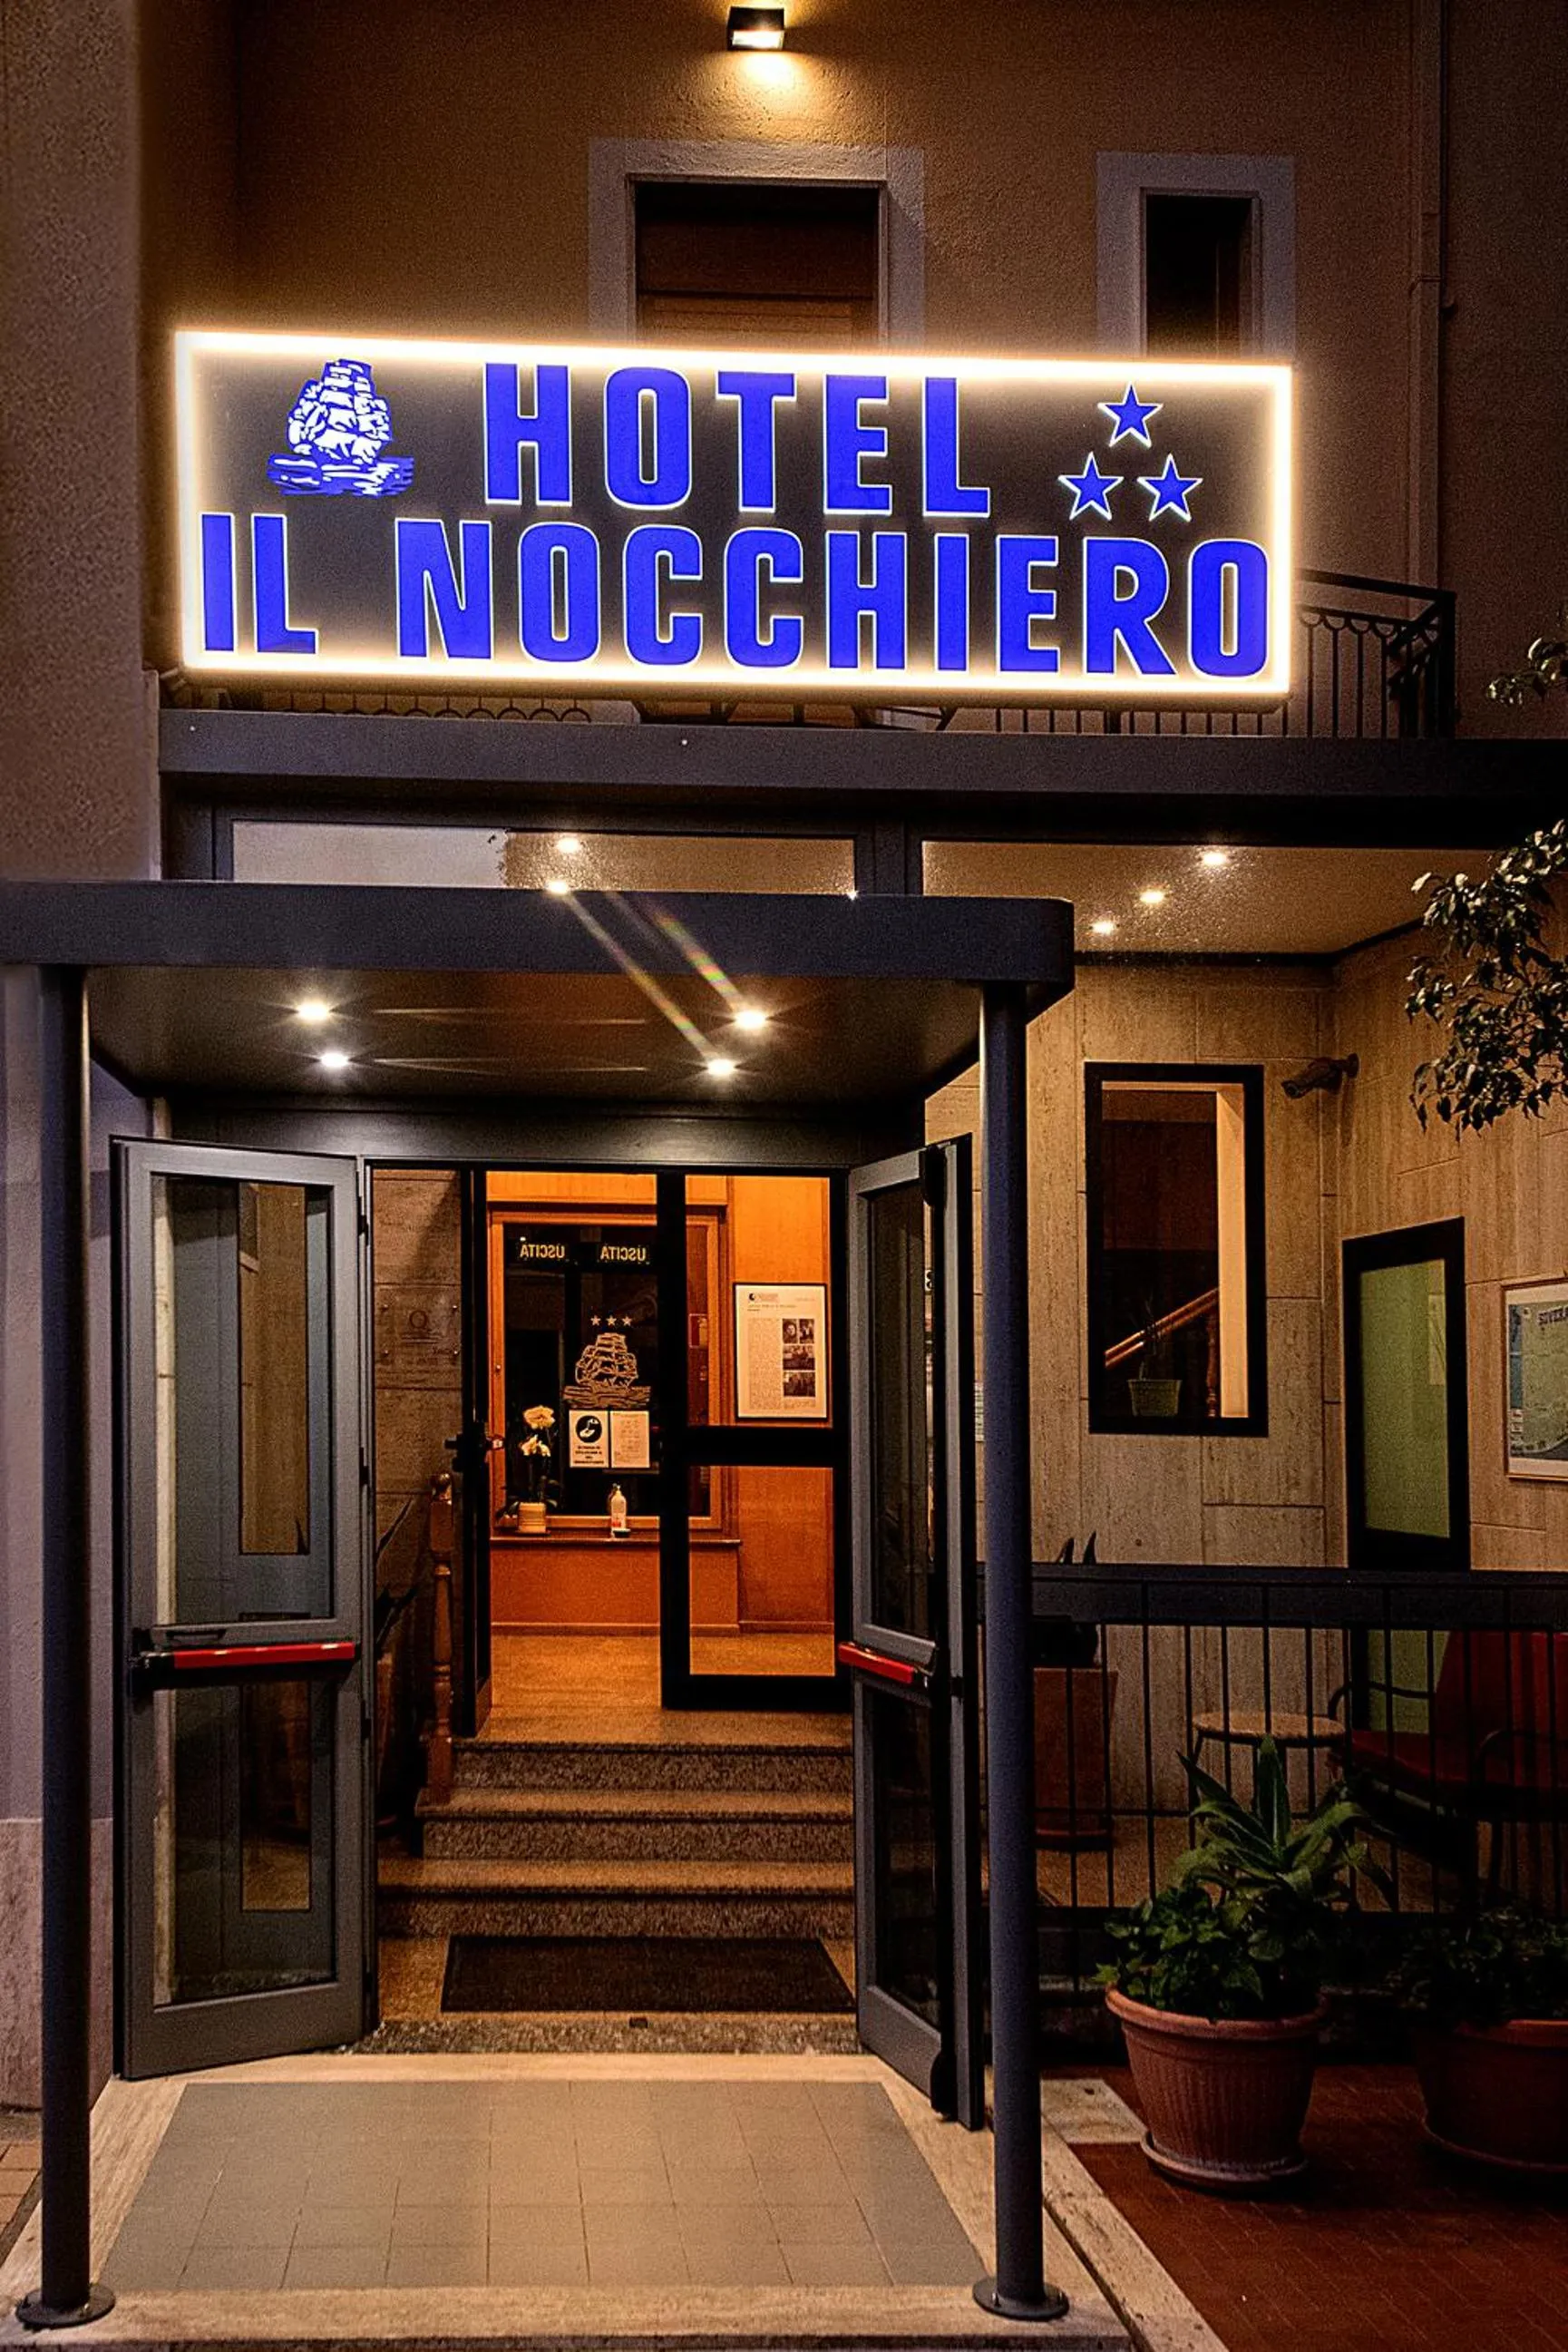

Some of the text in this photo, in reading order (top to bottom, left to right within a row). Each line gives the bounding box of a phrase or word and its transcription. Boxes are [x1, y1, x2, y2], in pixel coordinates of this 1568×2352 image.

[484, 363, 990, 519] HOTEL
[200, 512, 1270, 678] IL NOCCHIERO
